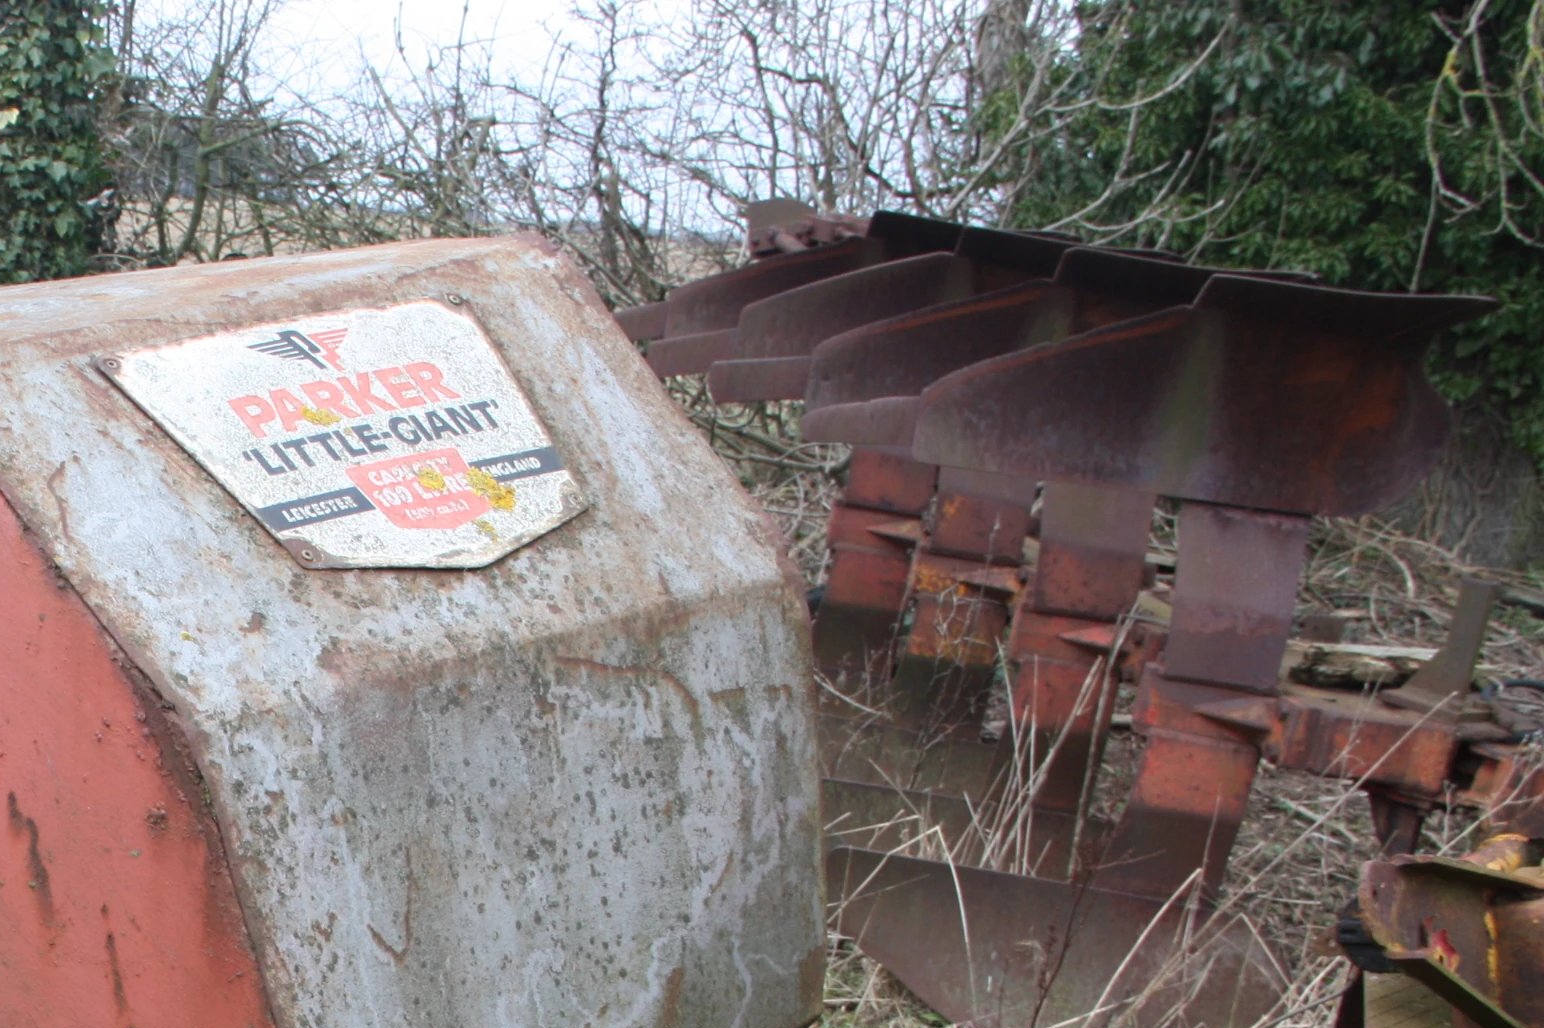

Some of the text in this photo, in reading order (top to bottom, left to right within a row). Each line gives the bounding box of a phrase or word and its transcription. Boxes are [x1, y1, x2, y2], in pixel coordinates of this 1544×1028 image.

[227, 361, 461, 438] PARKER
[373, 472, 473, 508] 100 LRE
[281, 495, 358, 522] LEICESTER
